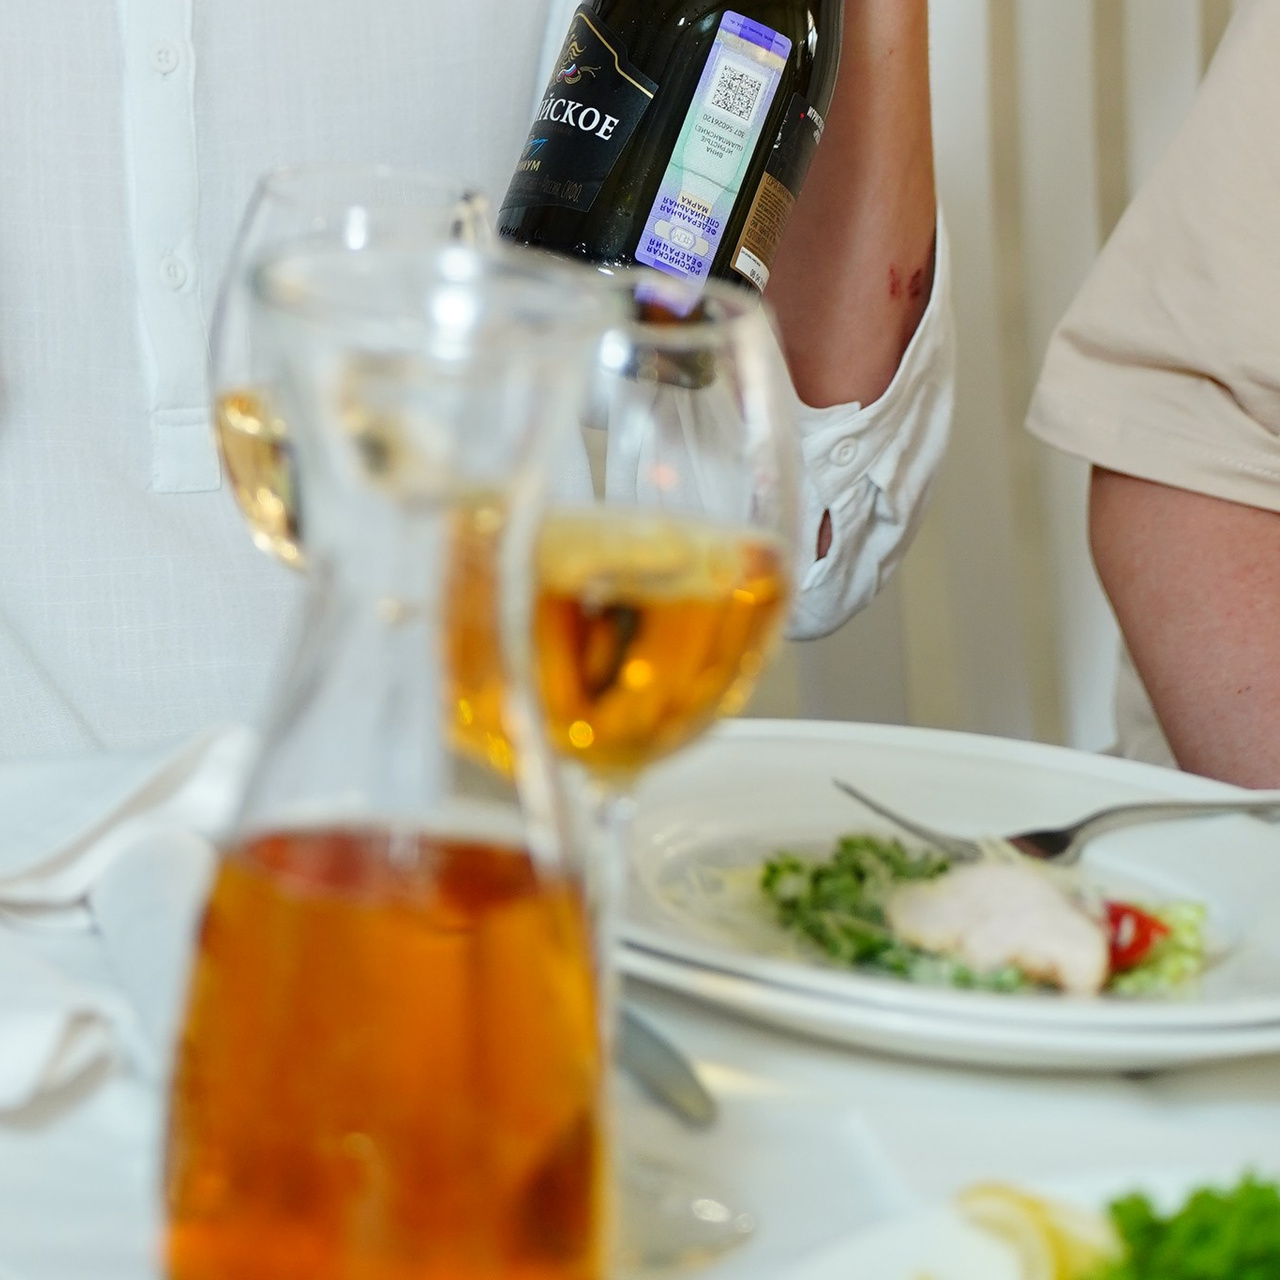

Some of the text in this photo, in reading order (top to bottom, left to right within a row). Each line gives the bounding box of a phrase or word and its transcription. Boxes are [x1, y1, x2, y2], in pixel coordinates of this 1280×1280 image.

[694, 124, 744, 152] (ШАМПАНСКИЕ)
[700, 135, 734, 155] ИГРИСТЫЕ
[706, 146, 724, 159] ВИНА
[663, 196, 720, 229] СПЕЦИАЛЬНАЯ
[681, 196, 709, 214] МАРКА
[660, 204, 717, 236] ФЕДЕРАЛЬНАЯ
[646, 245, 701, 276] РОССИЙСКАЯ
[649, 238, 703, 268] ФЕДЕРАЦИЯ
